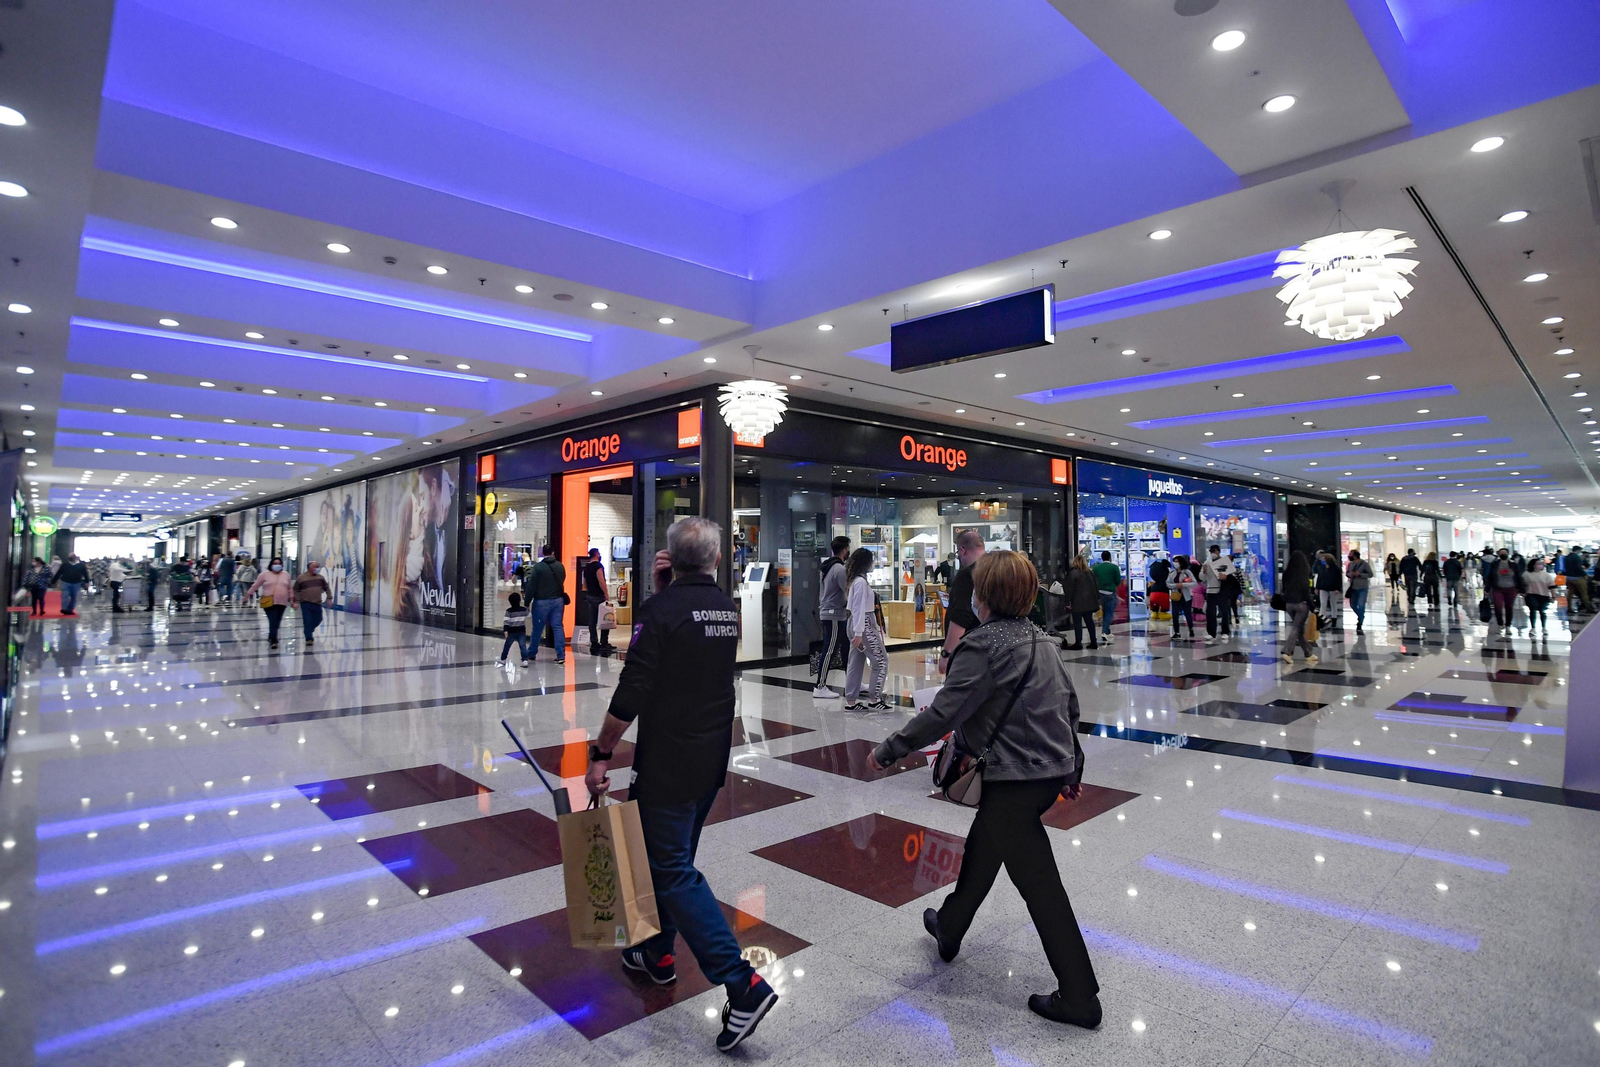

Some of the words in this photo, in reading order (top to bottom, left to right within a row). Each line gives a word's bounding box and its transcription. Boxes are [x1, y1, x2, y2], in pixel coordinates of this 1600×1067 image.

[561, 433, 620, 462] Orange
[678, 434, 700, 444] orange
[900, 434, 967, 471] Orange
[1148, 473, 1184, 497] juguettos
